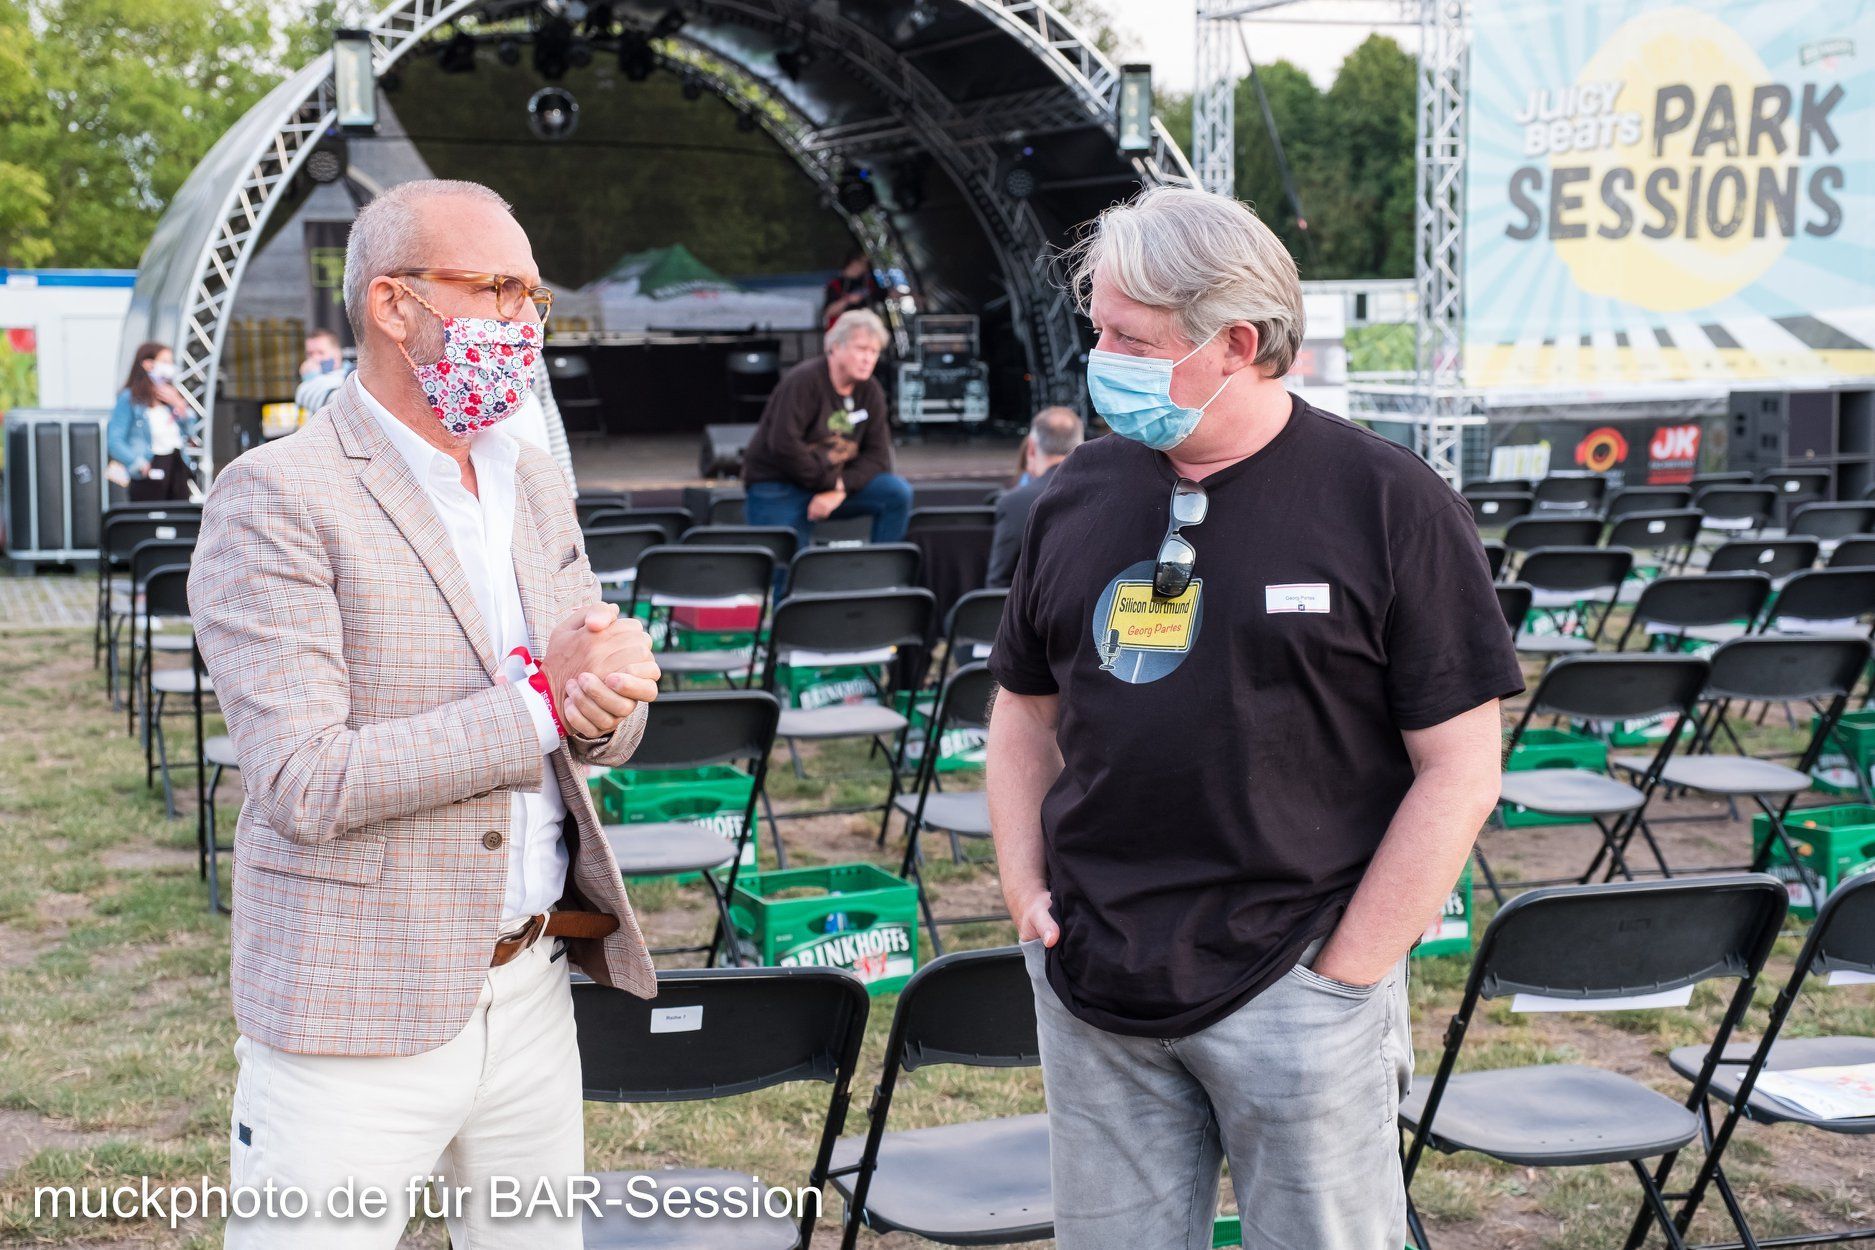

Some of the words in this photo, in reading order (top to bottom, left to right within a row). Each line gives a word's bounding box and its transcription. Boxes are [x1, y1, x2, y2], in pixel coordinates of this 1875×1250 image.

[1515, 82, 1625, 125] JUICY
[1653, 82, 1846, 158] PARK
[1505, 165, 1845, 241] SESSIONS
[1651, 425, 1699, 460] JK
[1119, 597, 1147, 614] Silicon
[1148, 598, 1191, 614] Dortmund
[1127, 624, 1153, 638] Georg
